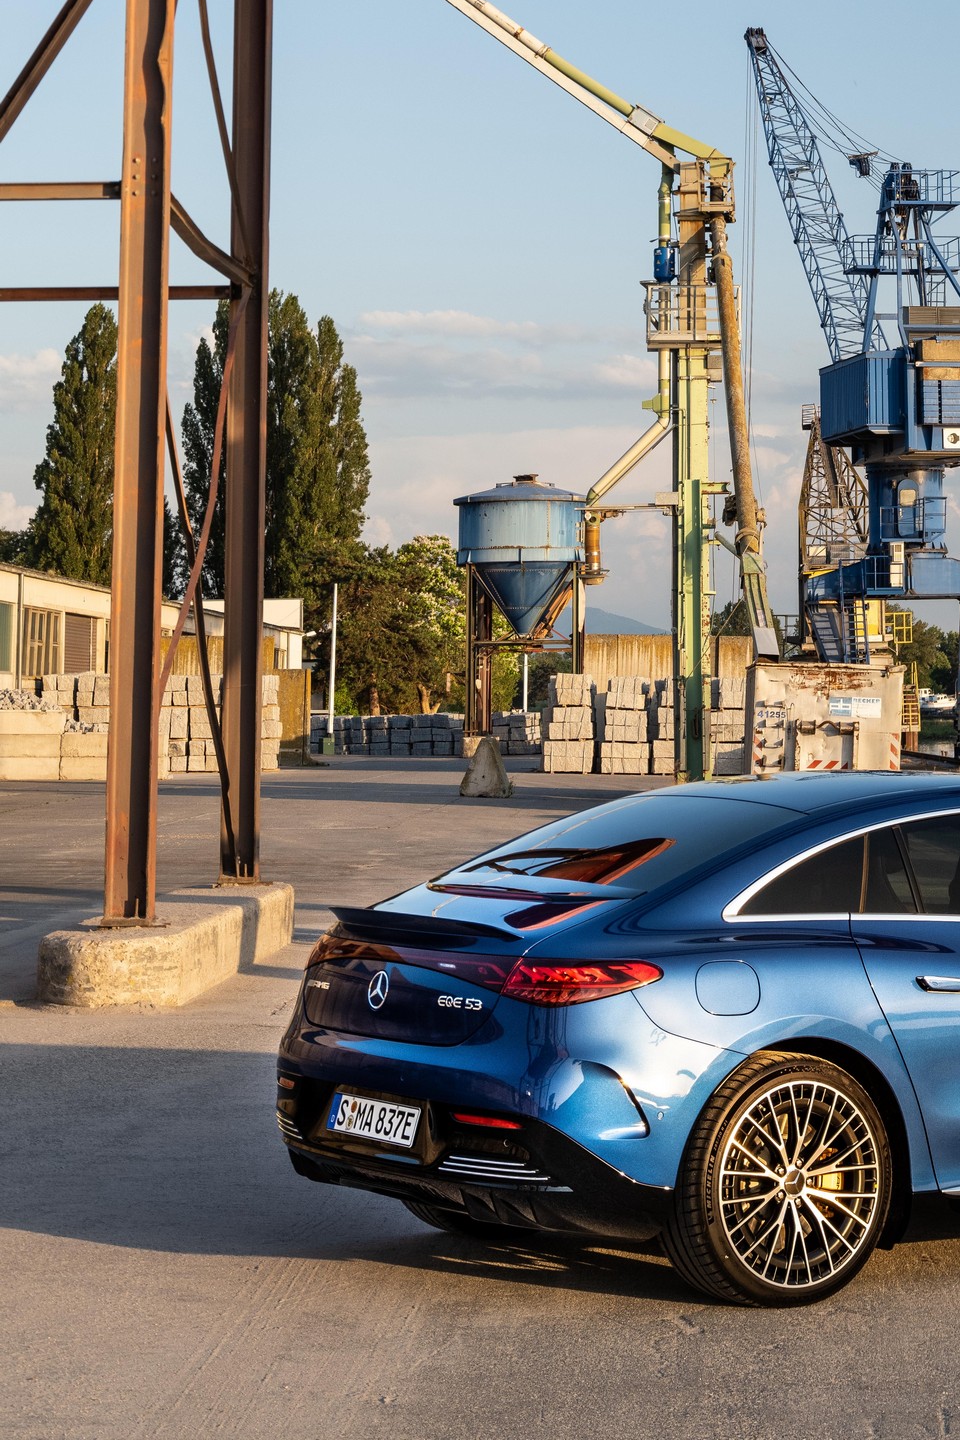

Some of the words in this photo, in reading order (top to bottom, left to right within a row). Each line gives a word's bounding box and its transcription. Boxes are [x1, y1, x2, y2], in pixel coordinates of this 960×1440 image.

[757, 710, 786, 719] 41255
[438, 995, 463, 1009] EQE
[465, 998, 482, 1010] 53
[337, 1099, 349, 1126] S
[353, 1102, 375, 1133] MA
[375, 1107, 415, 1141] 837E
[706, 1154, 715, 1209] MICHELIN
